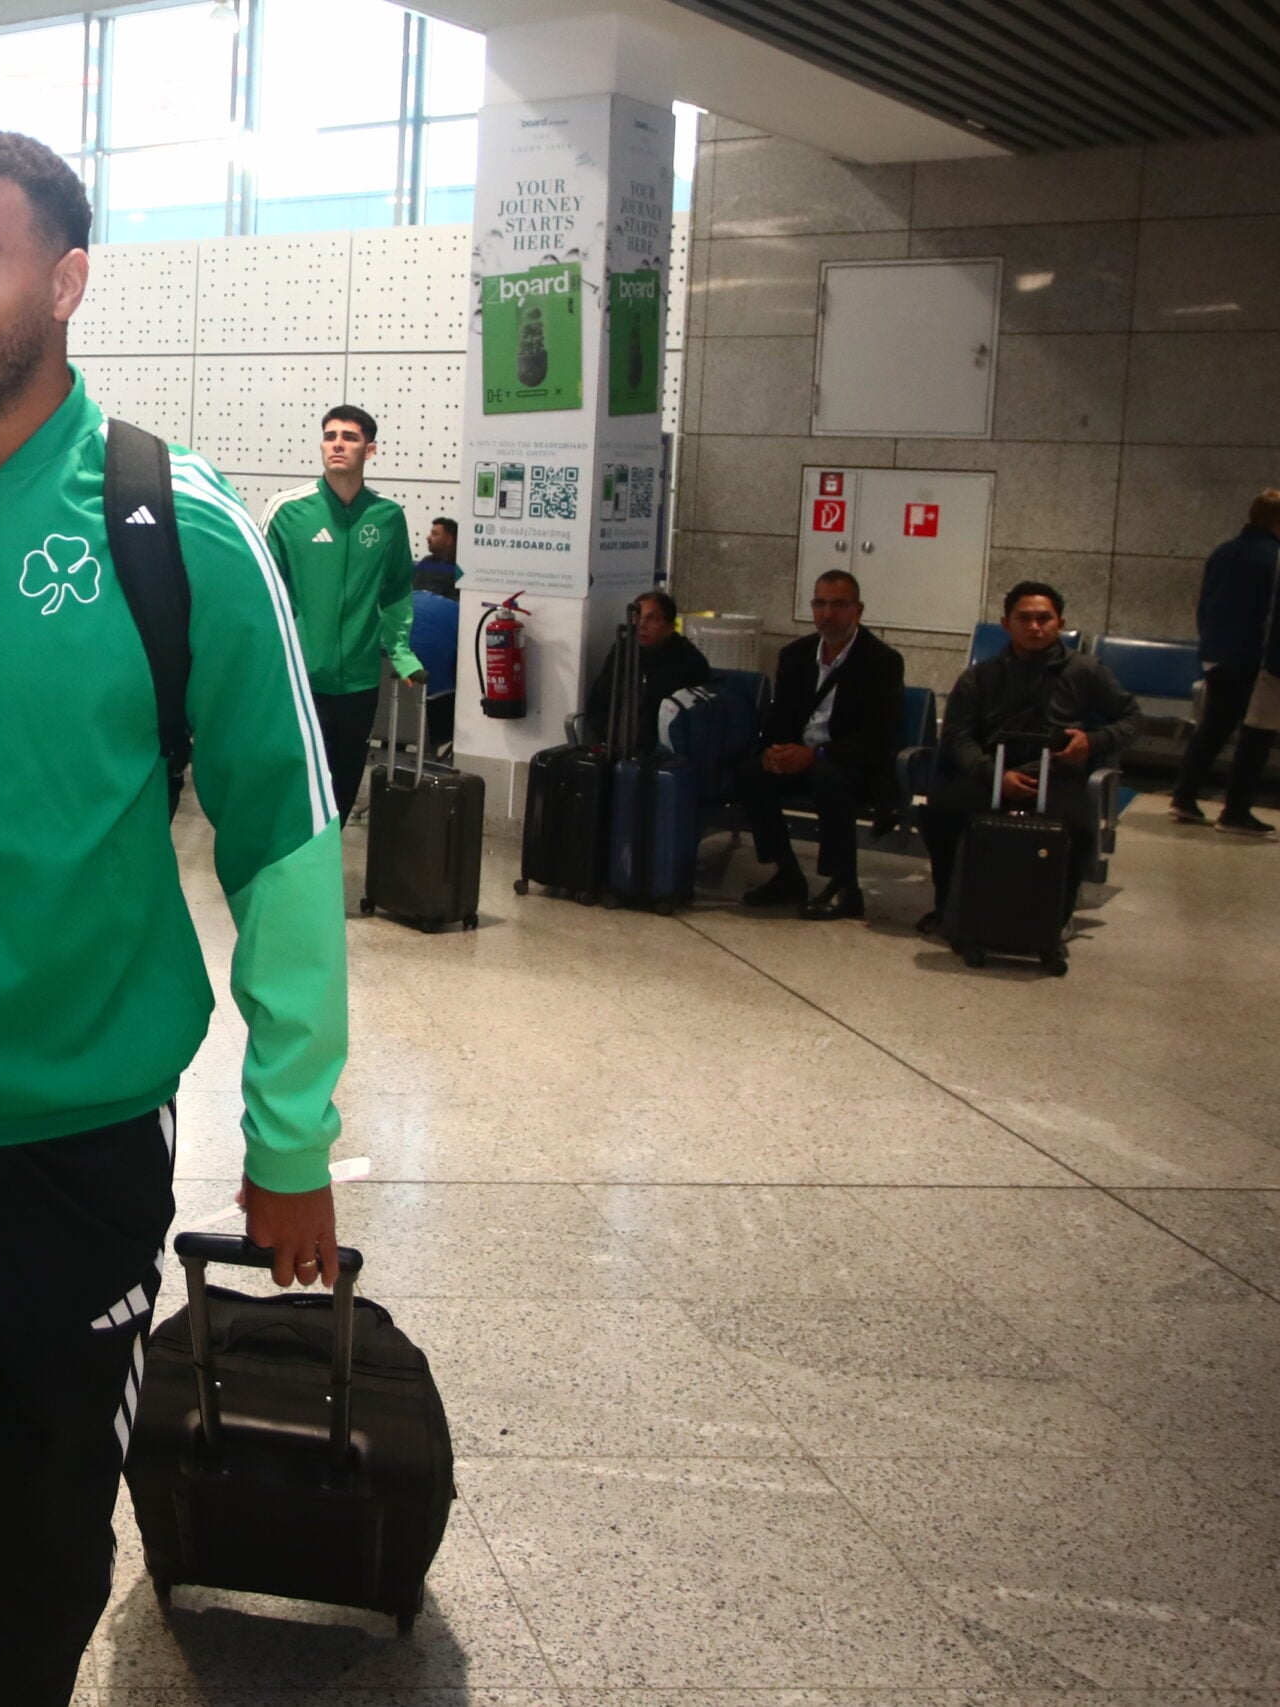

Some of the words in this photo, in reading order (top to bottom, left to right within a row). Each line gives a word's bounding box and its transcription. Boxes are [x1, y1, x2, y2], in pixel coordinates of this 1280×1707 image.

[516, 178, 566, 196] YOUR
[497, 195, 584, 217] JOURNEY
[505, 214, 574, 233] STARTS
[513, 233, 565, 250] HERE
[474, 538, 571, 551] READY.2BOARD.GR
